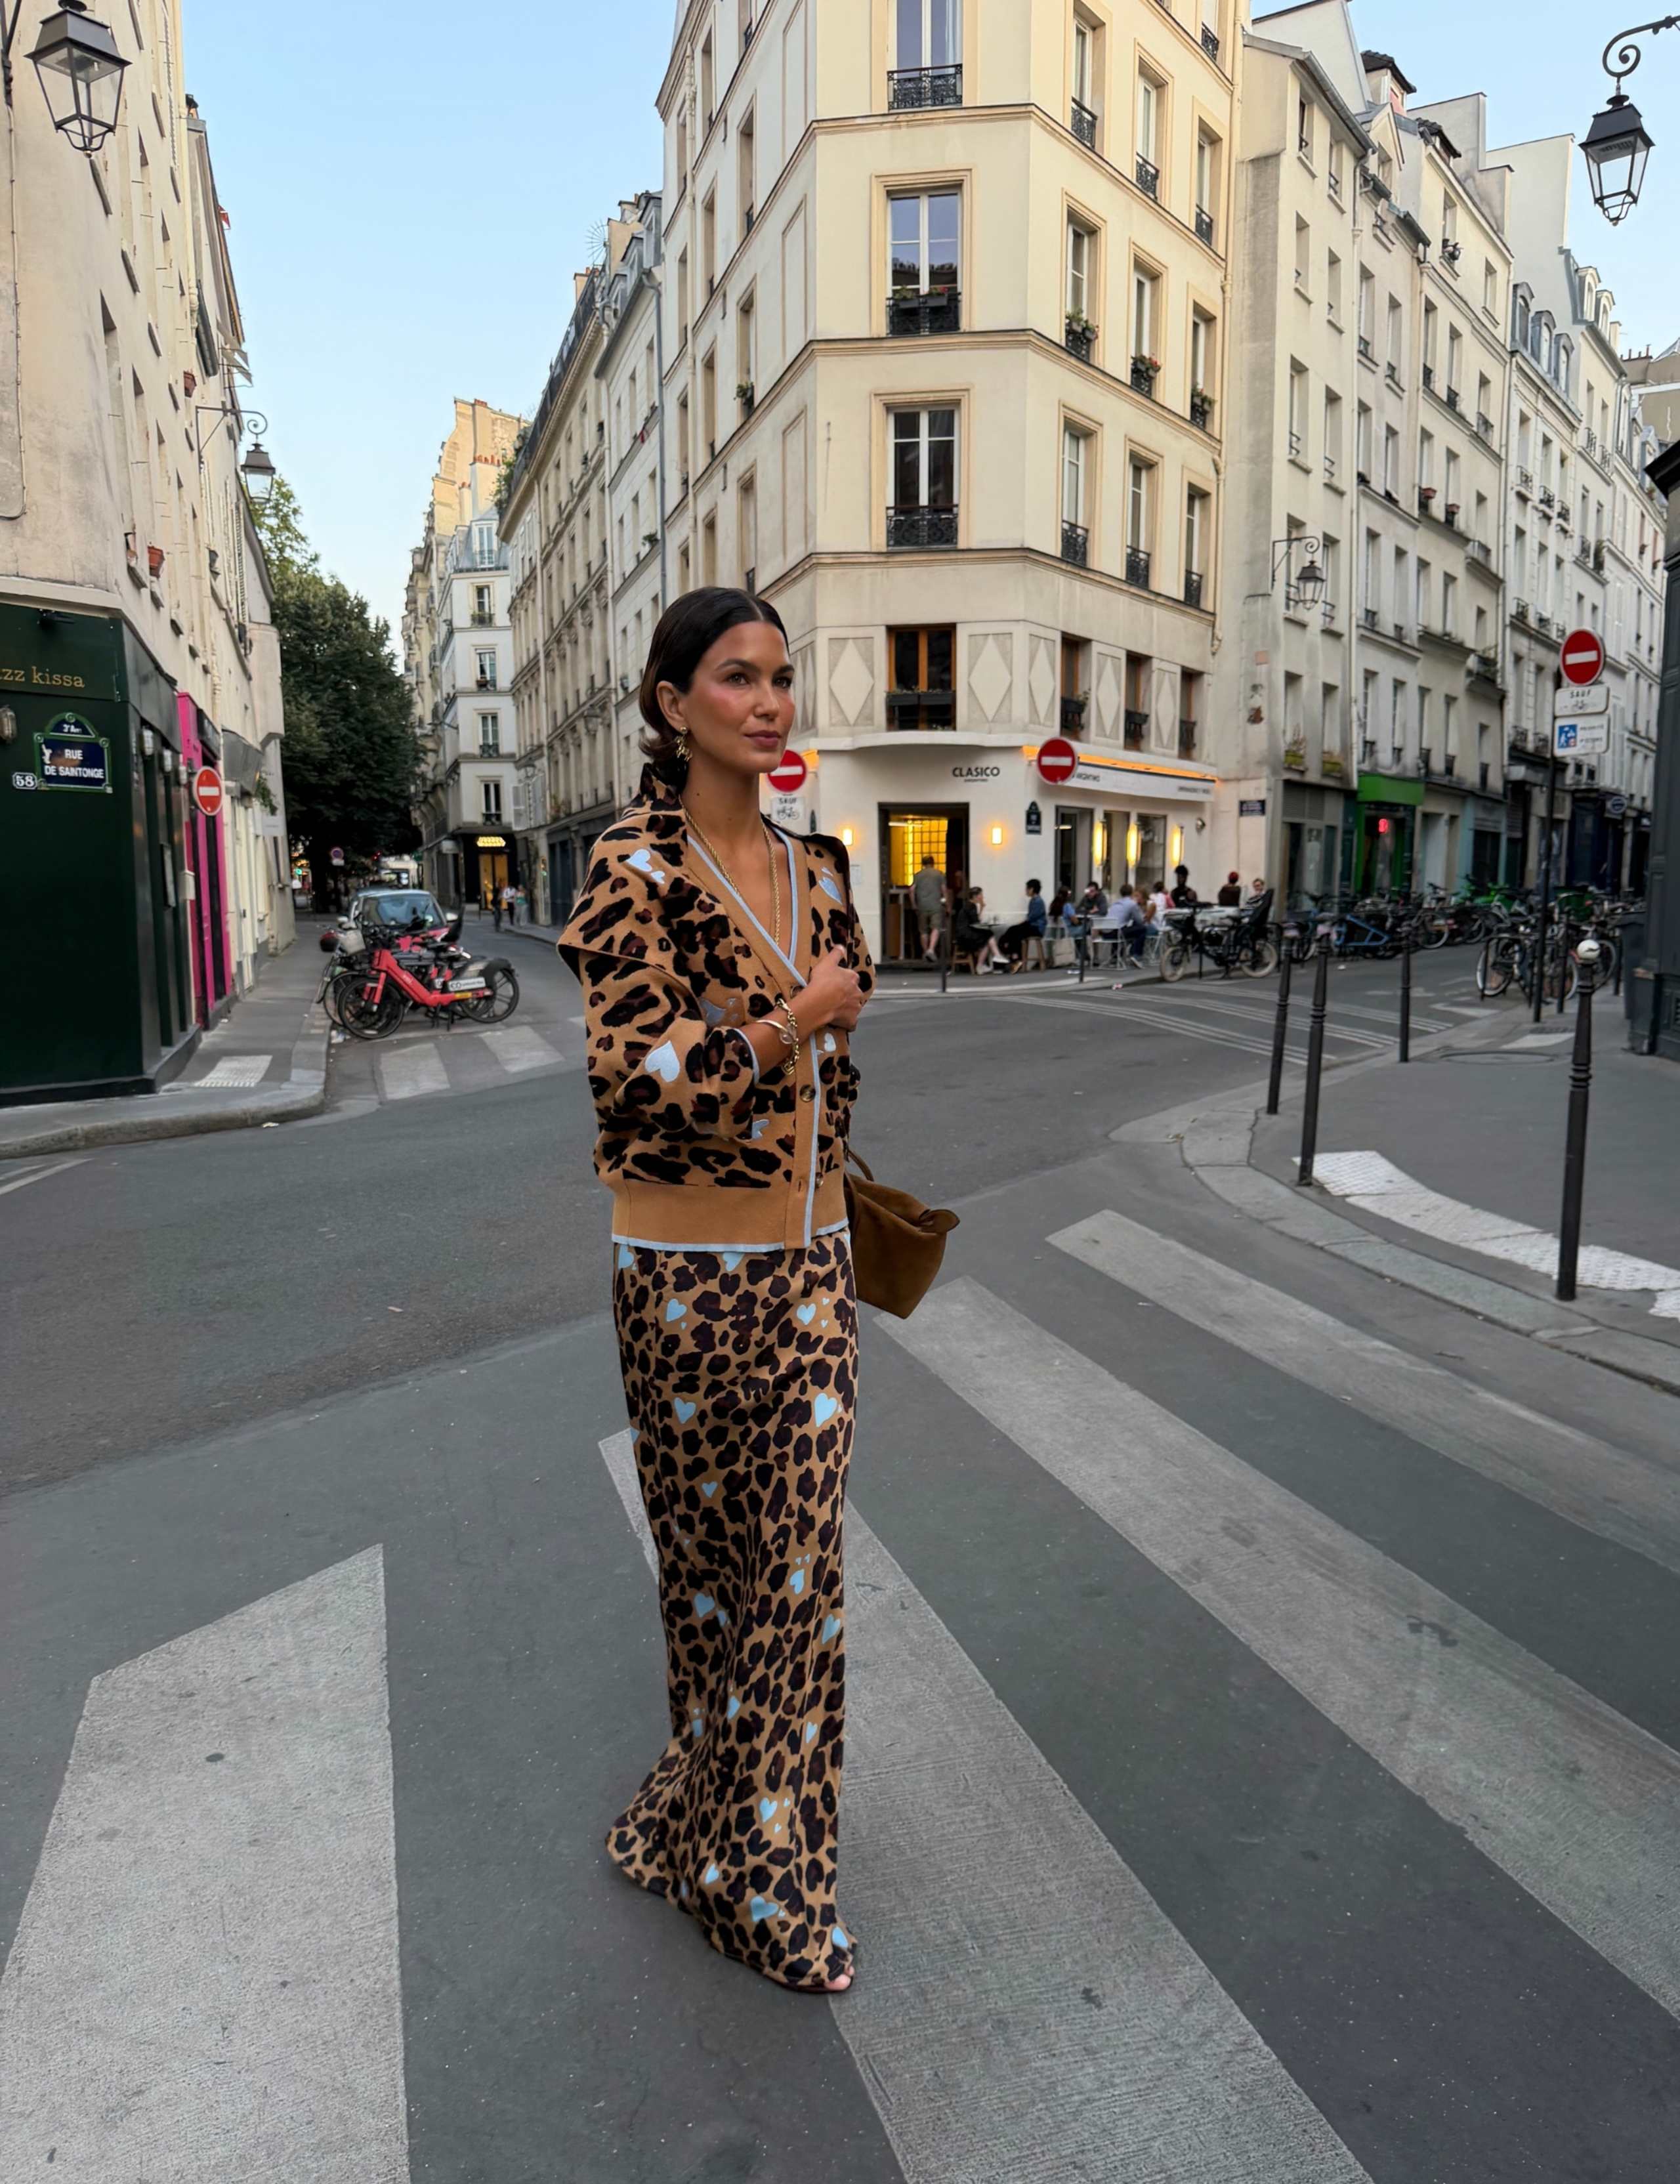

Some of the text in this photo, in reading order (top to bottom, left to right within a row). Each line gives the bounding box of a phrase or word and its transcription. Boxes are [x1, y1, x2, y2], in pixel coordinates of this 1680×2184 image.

[0, 665, 85, 688] zz kissa
[64, 749, 83, 760] RUE
[44, 765, 104, 779] DE SAINTONGE
[952, 766, 1000, 777] CLASICO
[15, 775, 35, 787] 58
